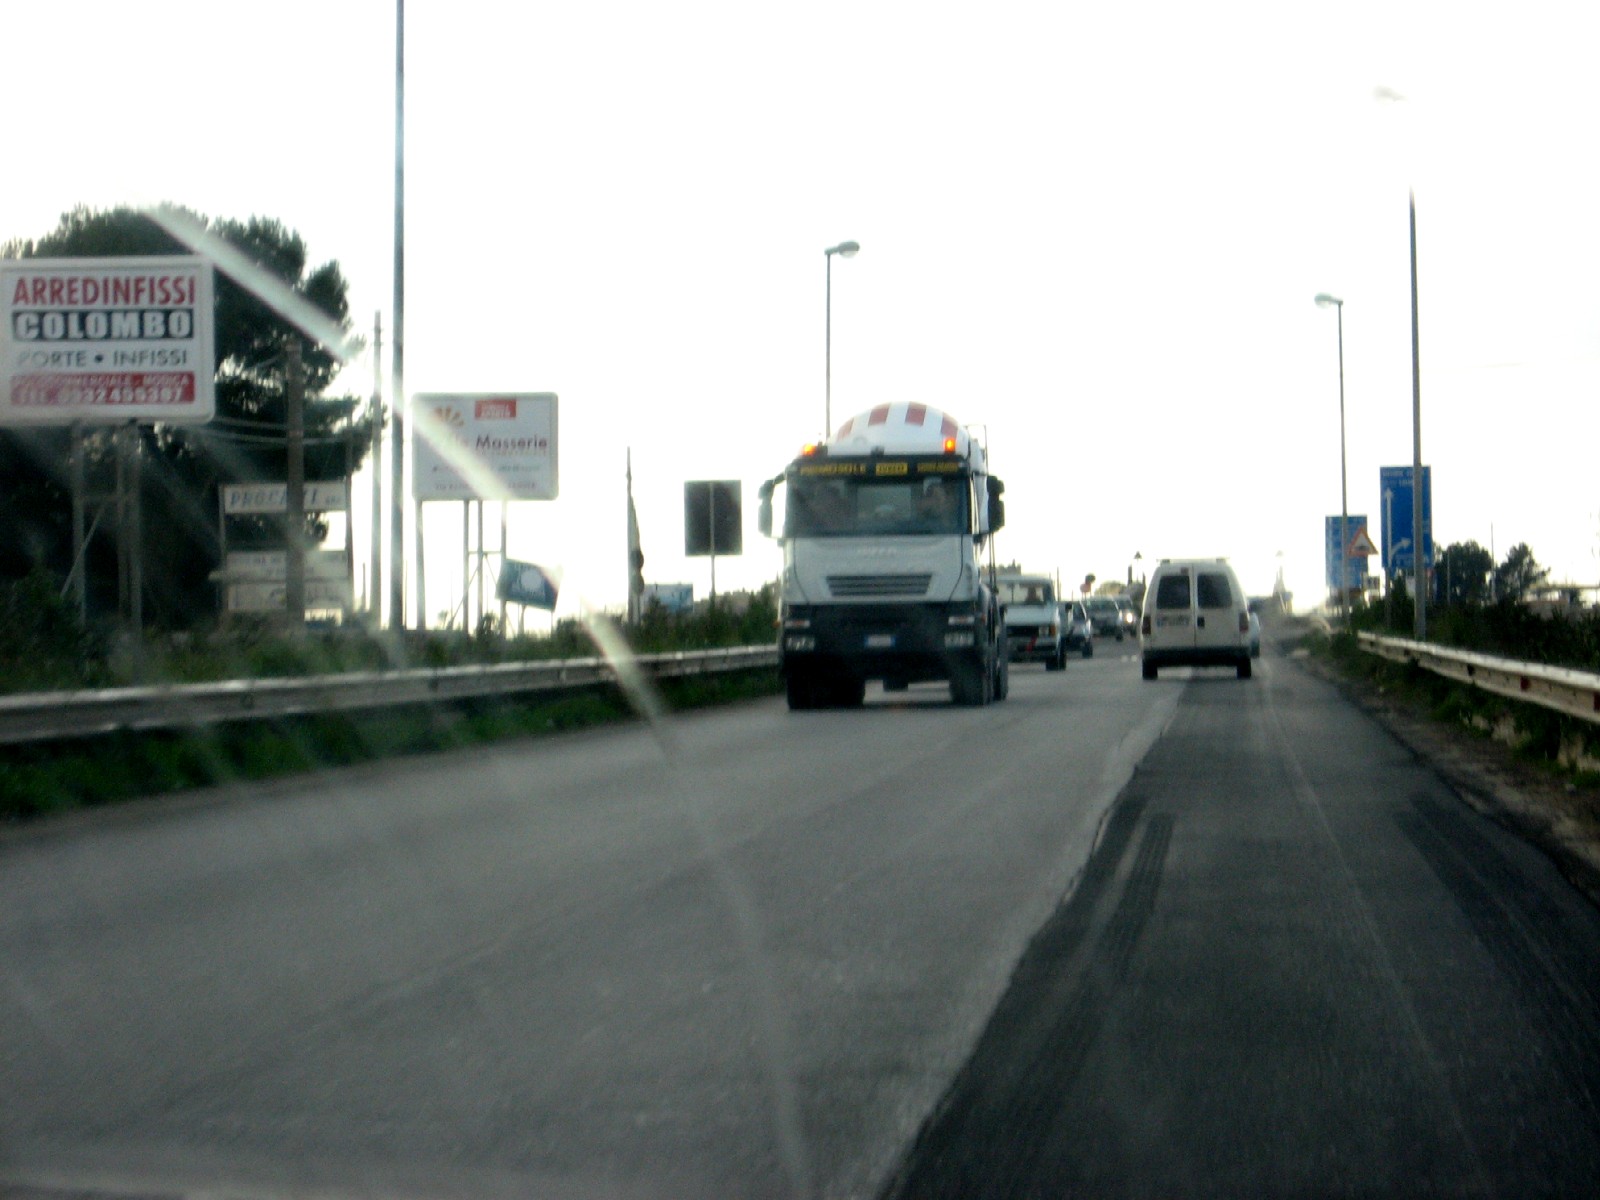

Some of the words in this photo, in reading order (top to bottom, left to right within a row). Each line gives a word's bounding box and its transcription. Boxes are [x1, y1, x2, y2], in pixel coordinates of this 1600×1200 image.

[12, 275, 196, 305] ARREDINFISSI
[15, 309, 192, 340] COLOMBO
[113, 349, 187, 366] INFISSI
